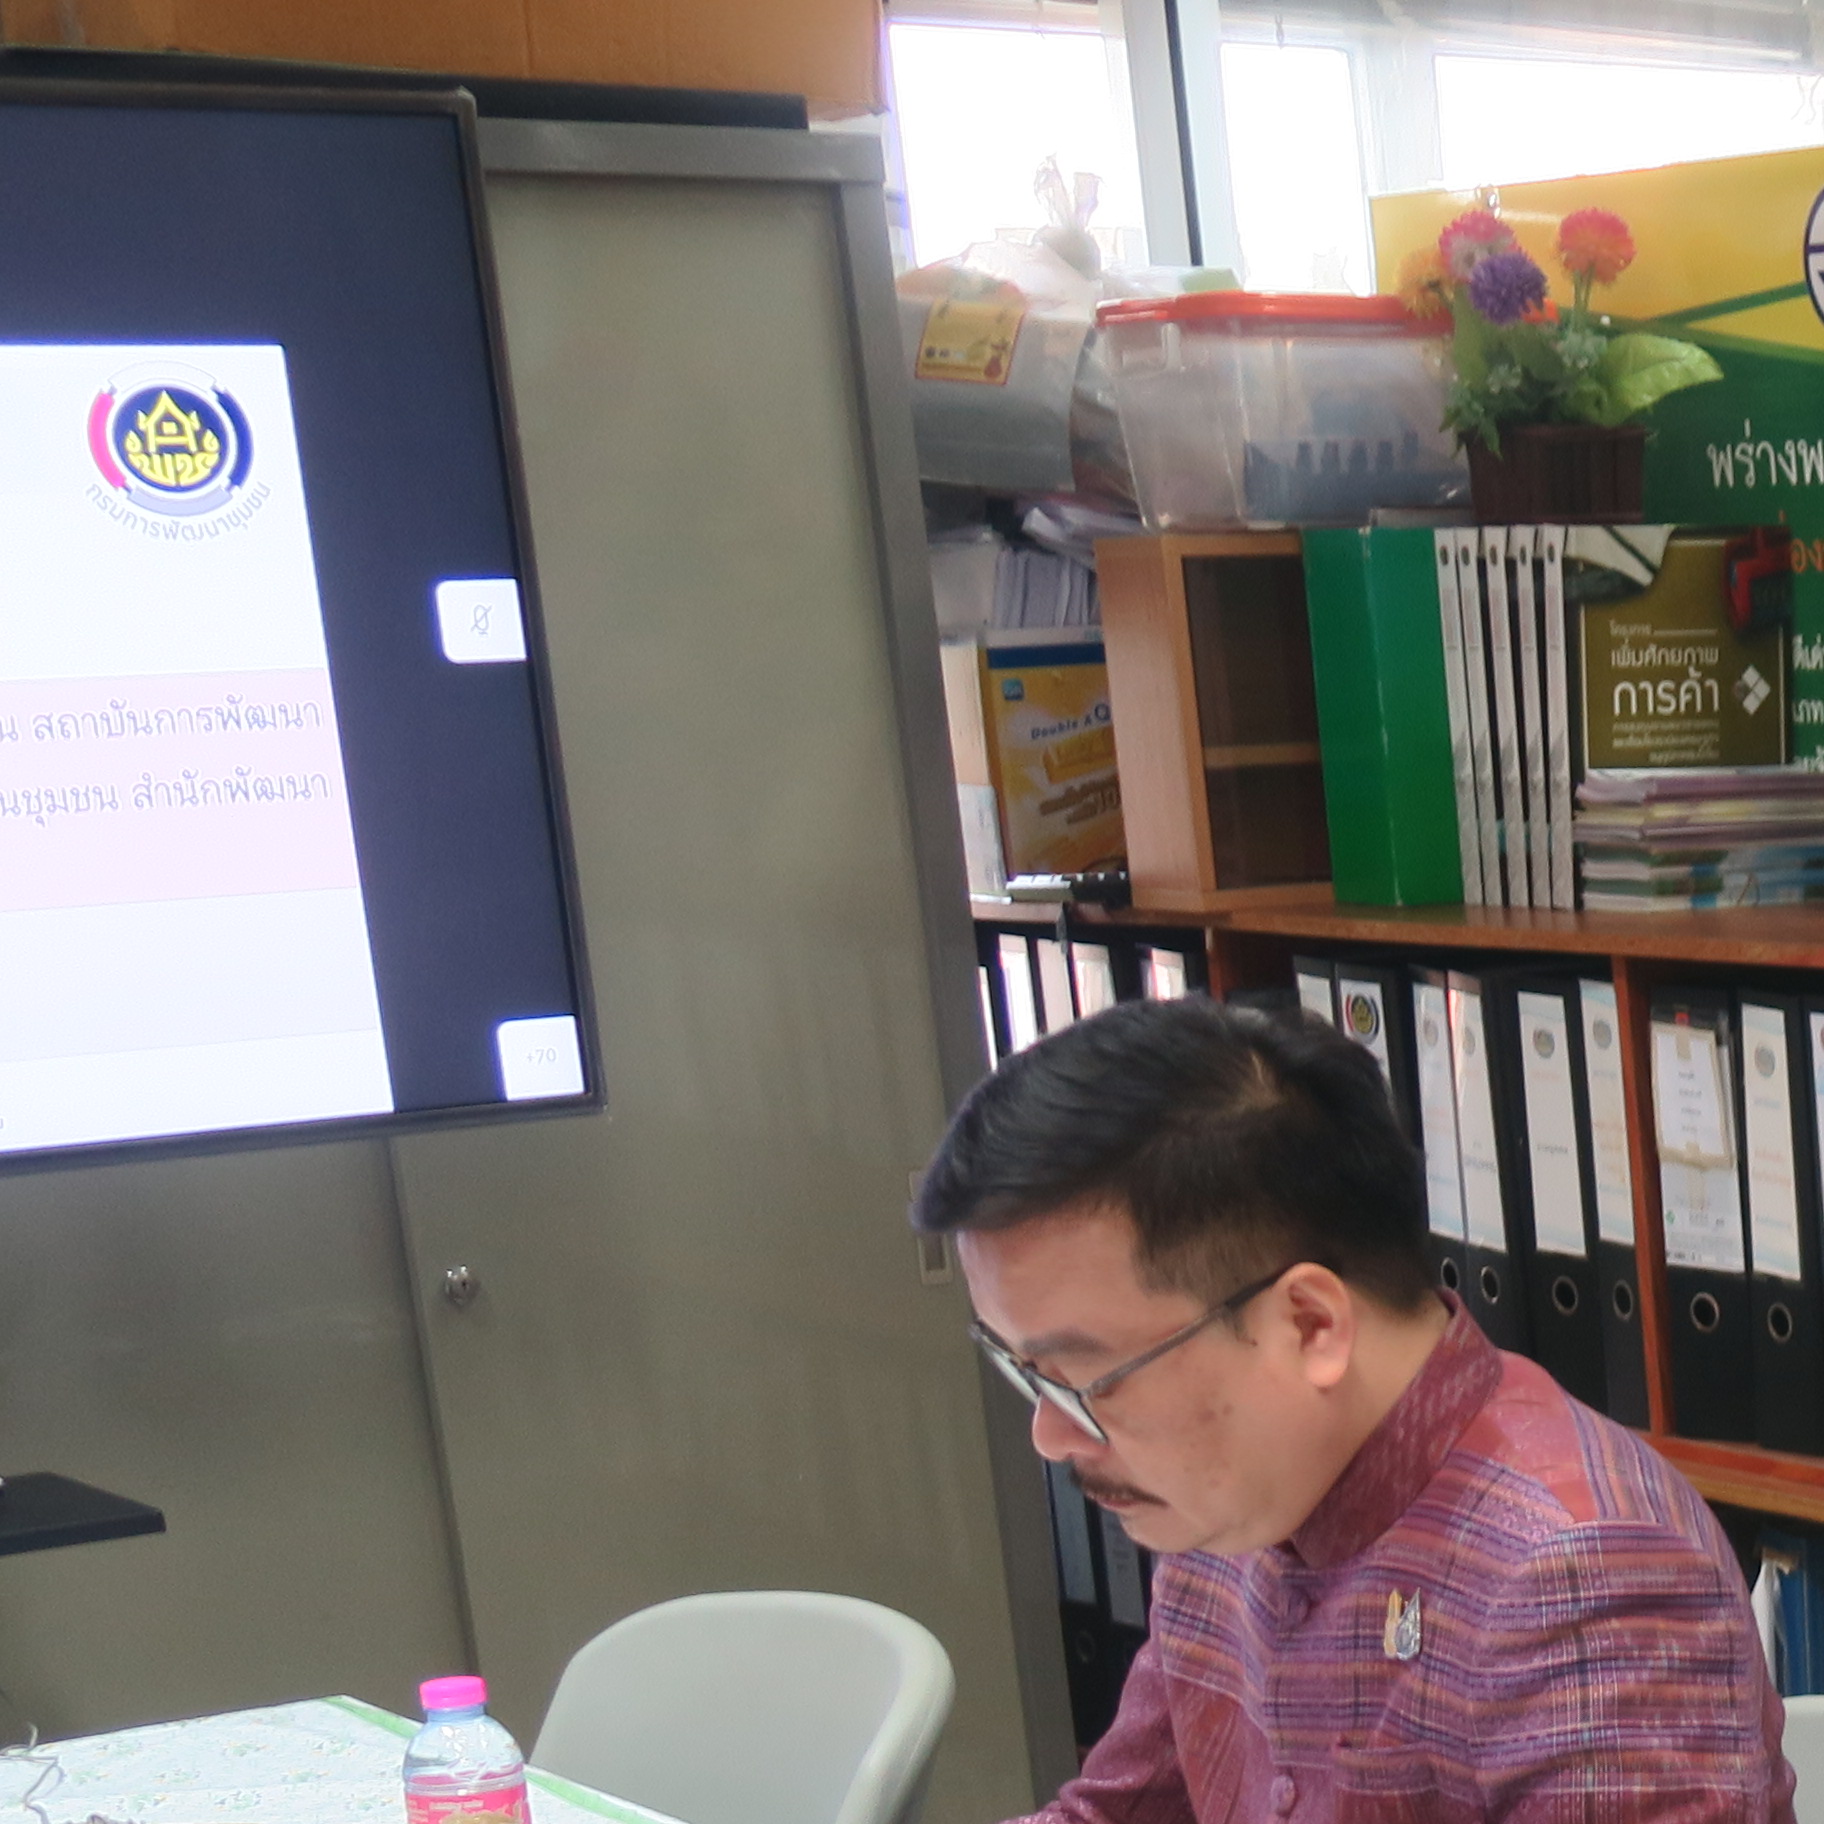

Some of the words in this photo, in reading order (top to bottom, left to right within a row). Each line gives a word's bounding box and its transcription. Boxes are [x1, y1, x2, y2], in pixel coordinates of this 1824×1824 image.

[86, 480, 272, 542] กรมการพัฒนาชุมชน
[1611, 637, 1720, 669] เพิ่มศักยภาพ
[1613, 666, 1720, 717] การค้า
[32, 693, 323, 743] สถาบันการพัฒนา
[1030, 716, 1079, 741] Double
[132, 765, 331, 812] สำนักพัฒนา
